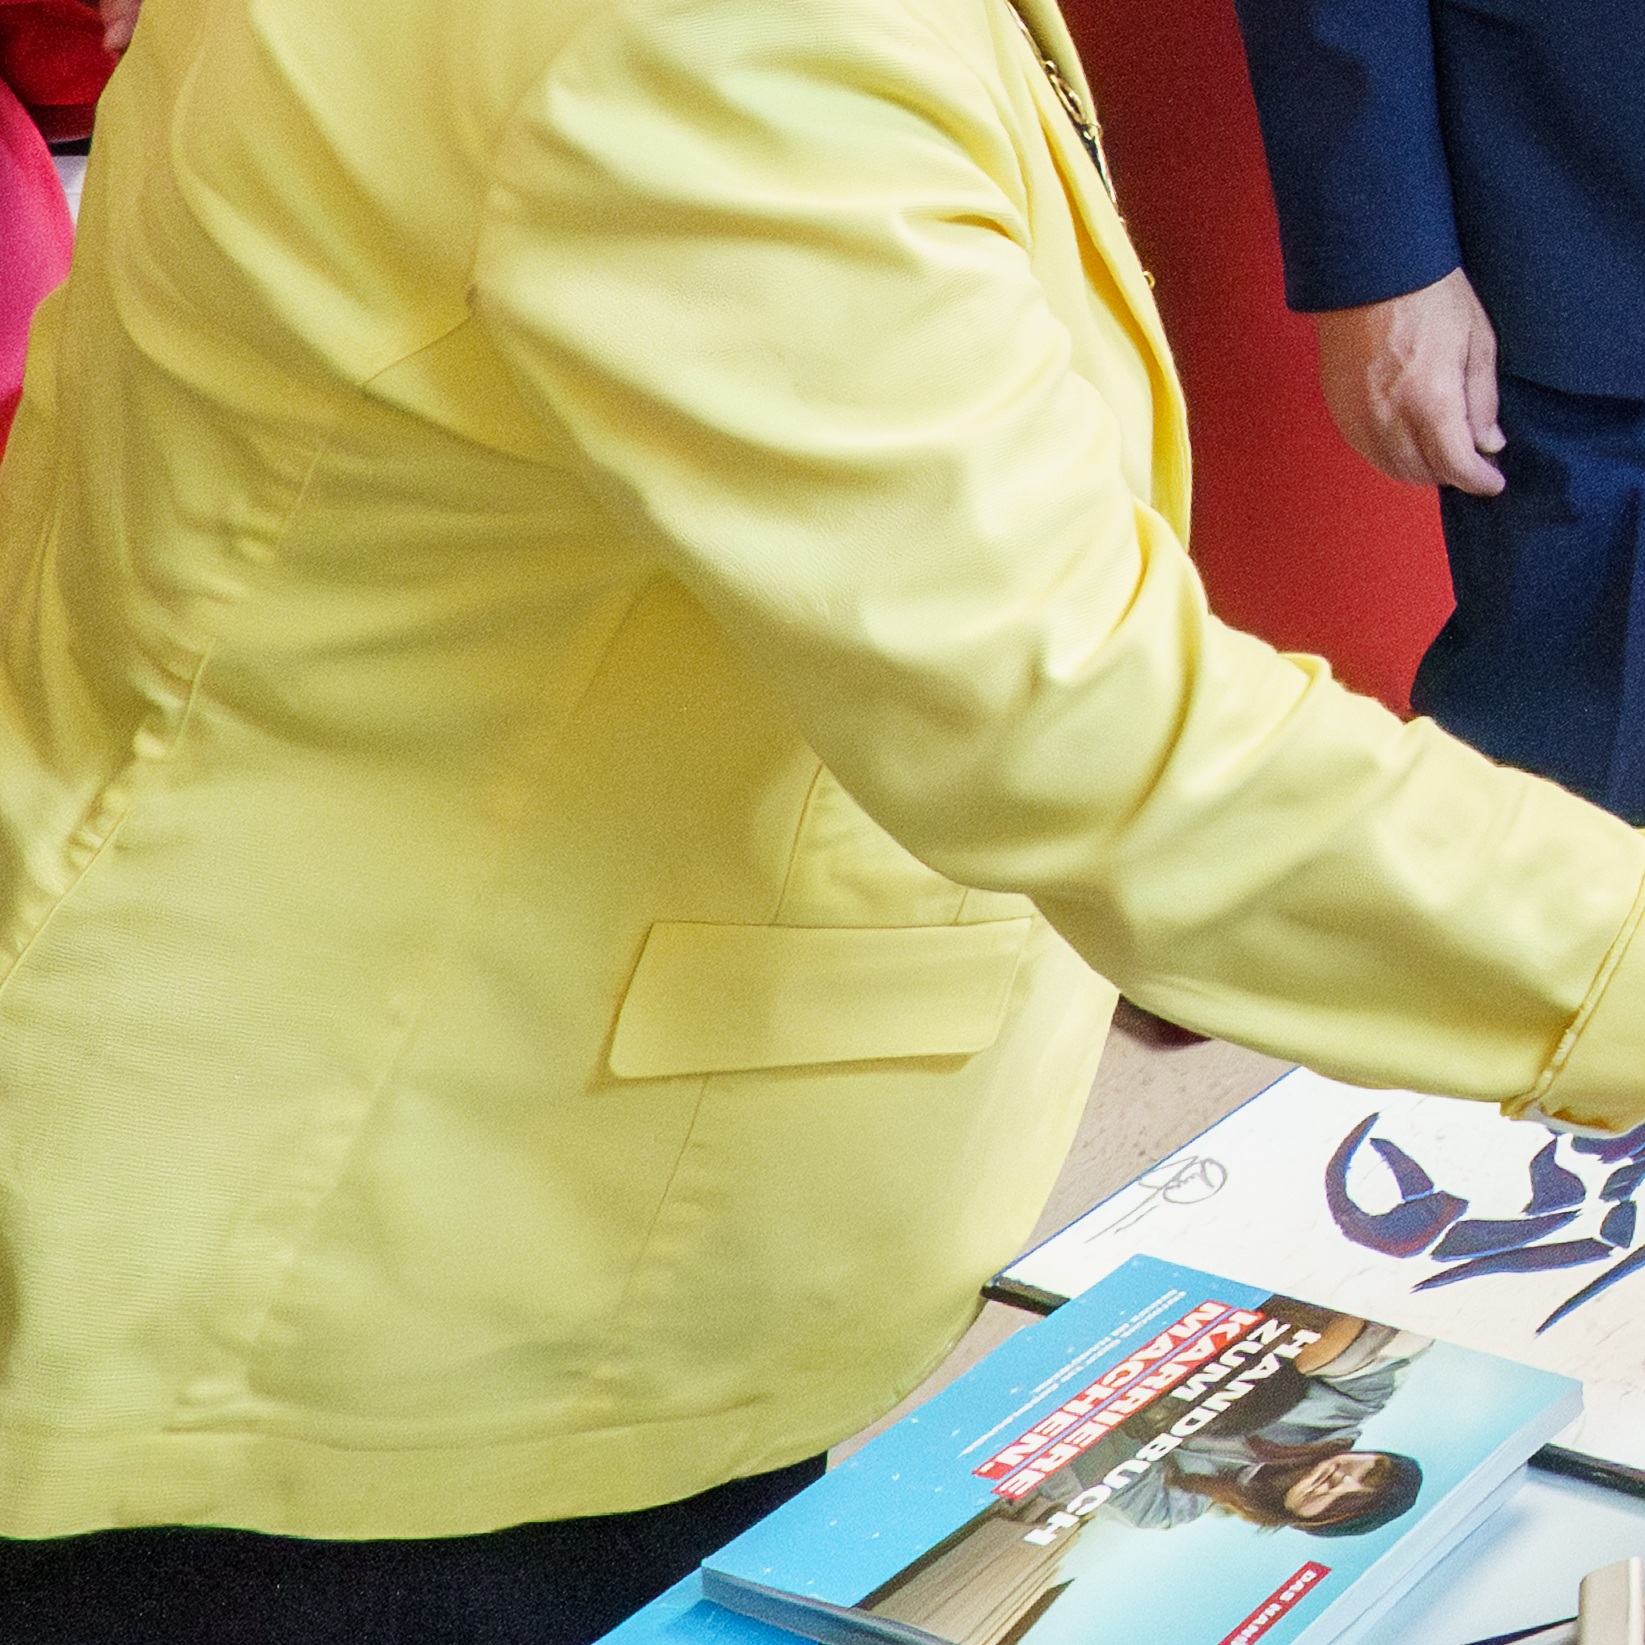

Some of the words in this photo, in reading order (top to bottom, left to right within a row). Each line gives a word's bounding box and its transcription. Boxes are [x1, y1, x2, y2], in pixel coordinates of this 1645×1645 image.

[980, 1300, 1227, 1475] MACHEN.
[998, 1310, 1259, 1496] KARRIERE
[1023, 1328, 1322, 1546] HANDBUCH
[1169, 1318, 1291, 1402] ZUM
[1279, 1568, 1318, 1603] DAS
